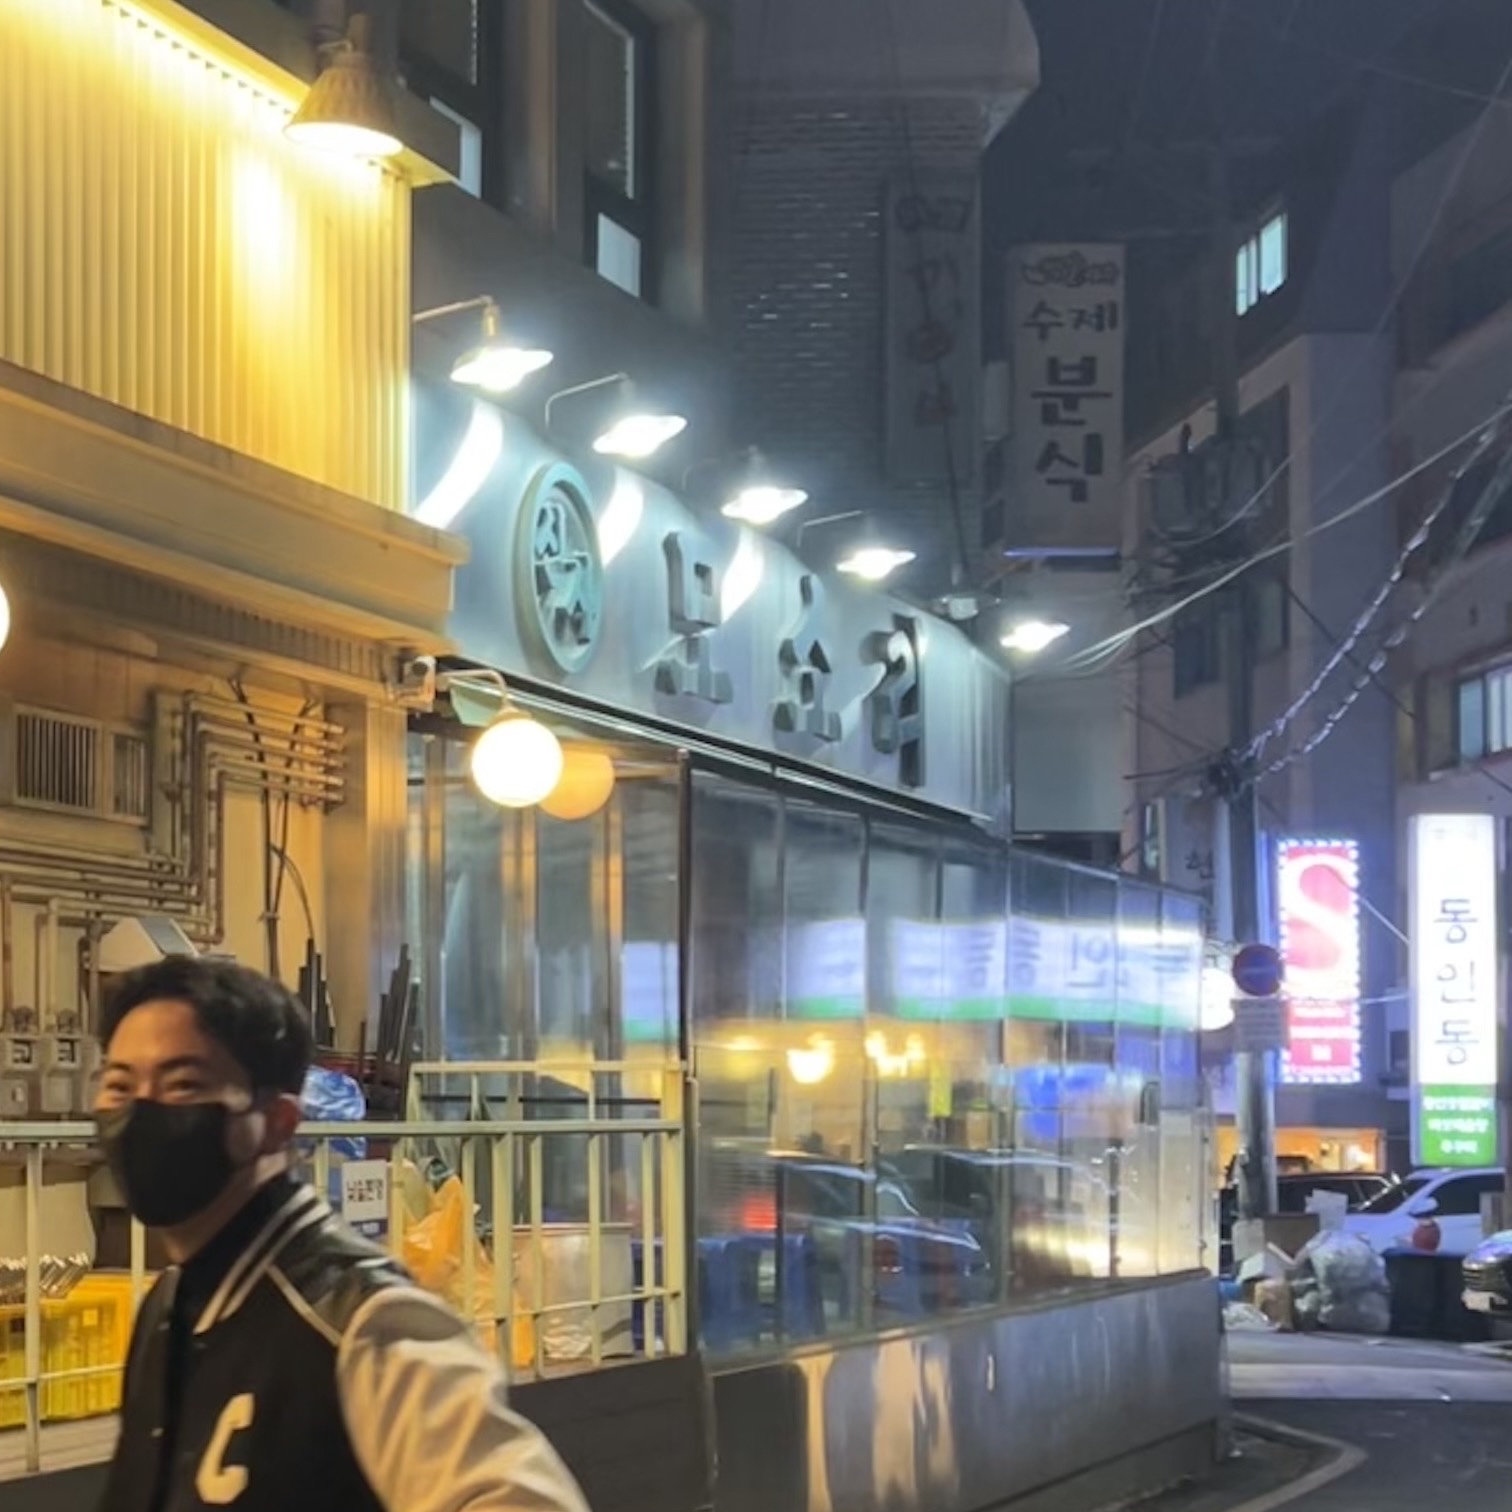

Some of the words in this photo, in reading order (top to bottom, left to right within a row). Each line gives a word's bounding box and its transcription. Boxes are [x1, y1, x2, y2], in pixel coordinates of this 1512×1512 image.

[1031, 354, 1113, 504] 분식
[1433, 898, 1480, 1067] 동인동
[195, 1392, 256, 1505] C
